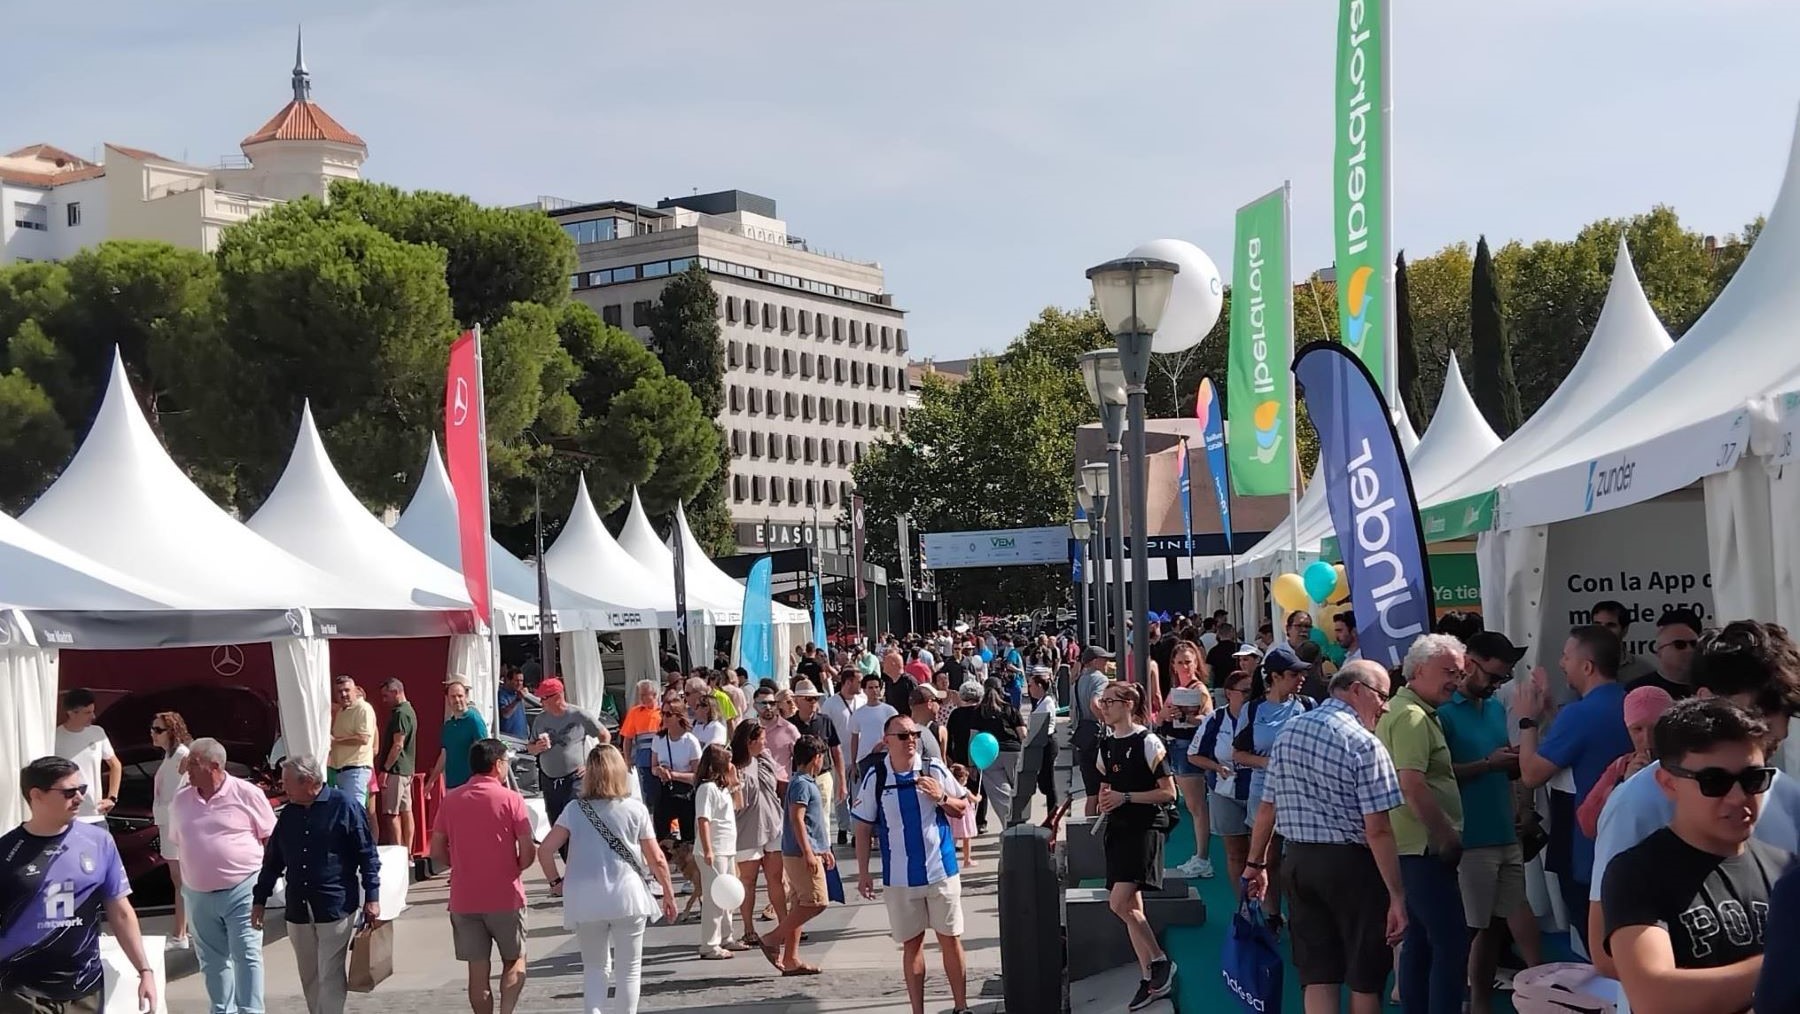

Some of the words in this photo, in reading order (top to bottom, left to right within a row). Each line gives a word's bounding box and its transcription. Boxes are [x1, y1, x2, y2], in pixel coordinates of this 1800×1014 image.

[1596, 454, 1636, 497] zunder
[991, 537, 1016, 548] VEM
[1567, 574, 1614, 593] Con
[1621, 571, 1642, 591] la
[1648, 571, 1696, 594] App
[1432, 586, 1453, 600] Ya
